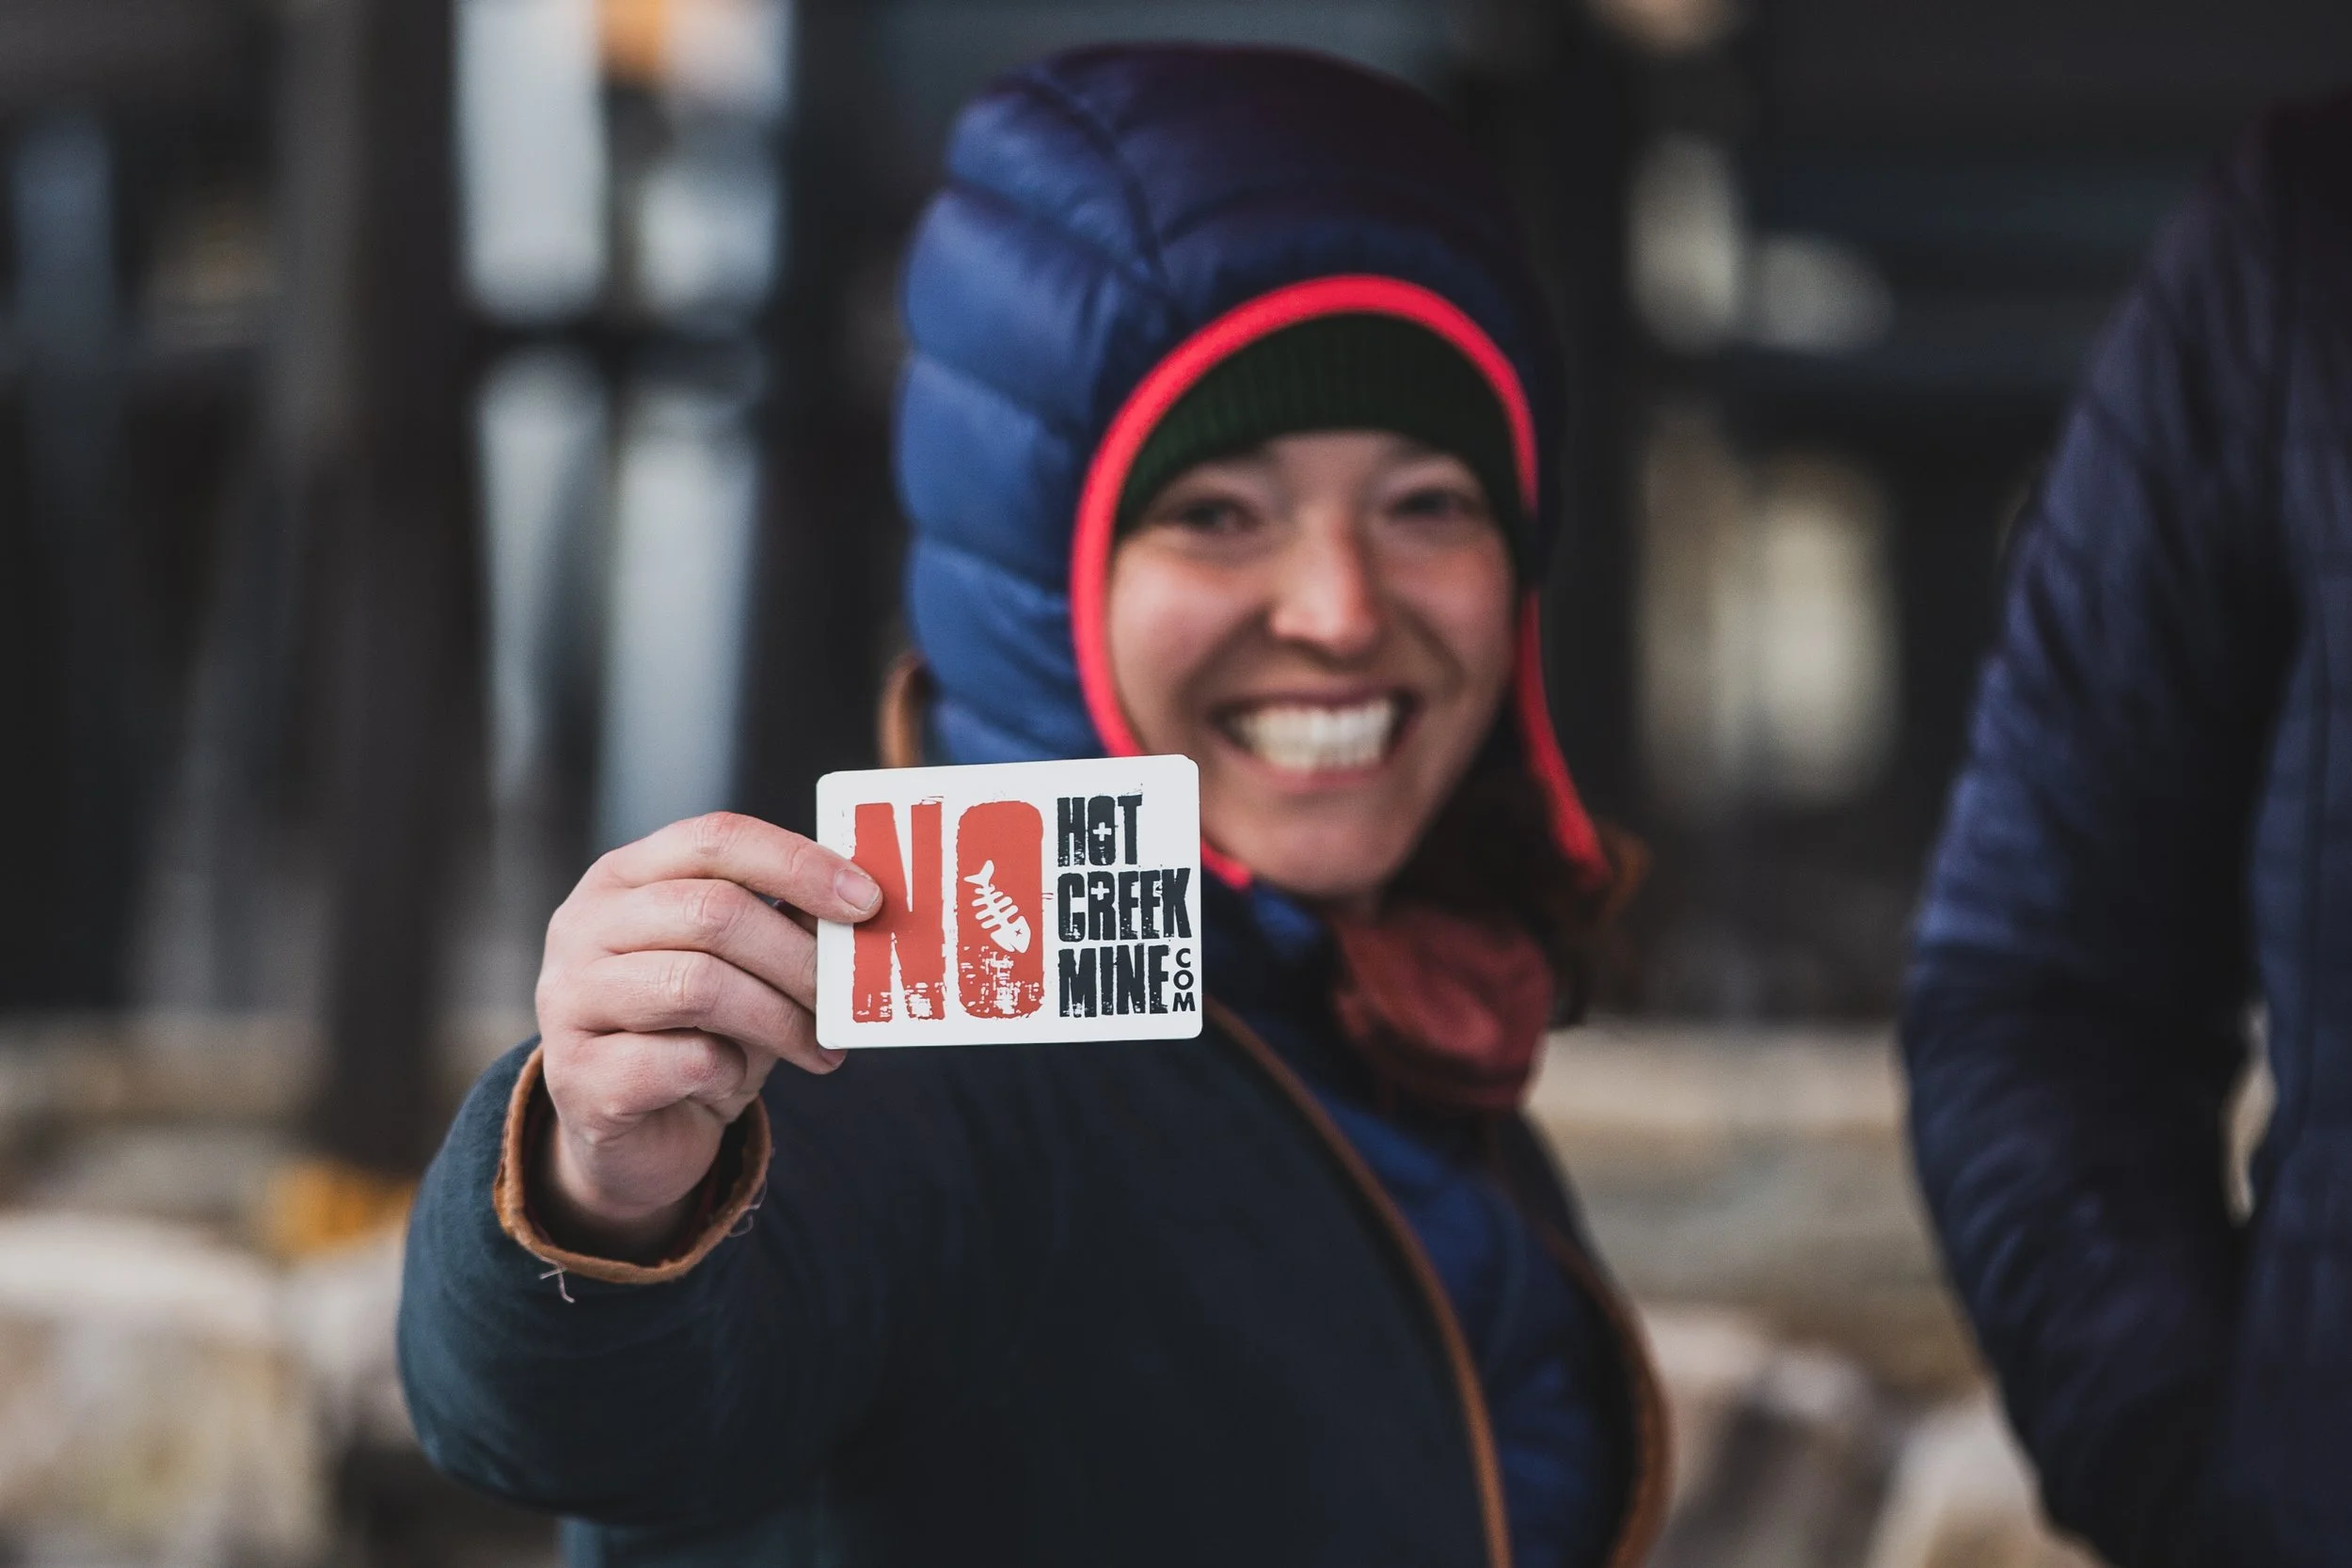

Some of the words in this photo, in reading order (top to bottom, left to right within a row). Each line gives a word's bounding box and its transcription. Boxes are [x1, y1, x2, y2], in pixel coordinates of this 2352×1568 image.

[1057, 794, 1142, 866] HOT
[851, 798, 1044, 1022] NO
[1057, 867, 1192, 942] CREEK
[1058, 944, 1169, 1017] MINE
[1172, 948, 1196, 1012] COM
